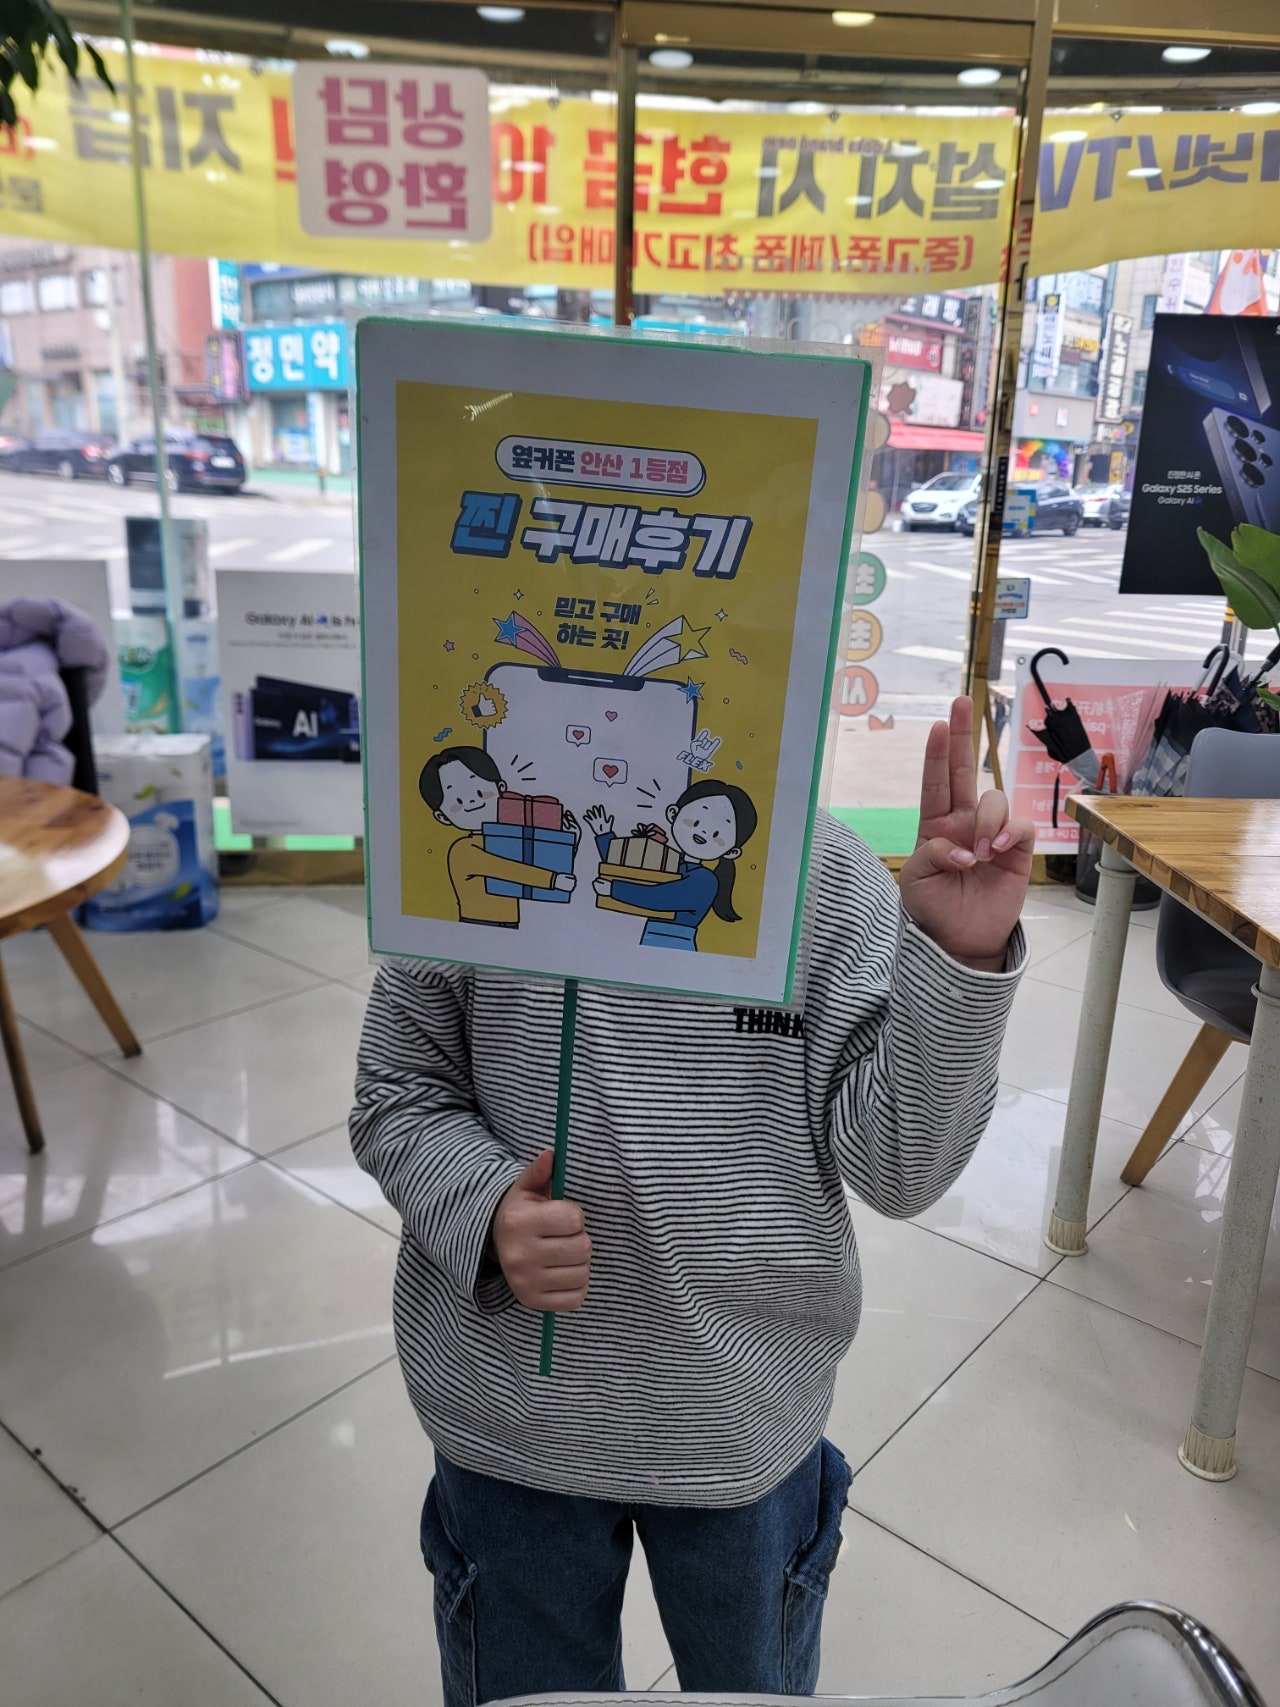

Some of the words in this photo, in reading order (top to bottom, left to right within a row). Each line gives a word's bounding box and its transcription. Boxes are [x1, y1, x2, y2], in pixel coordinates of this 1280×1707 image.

[511, 443, 576, 474] 옆커폰
[579, 450, 624, 478] 안산
[629, 456, 690, 485] 1등점
[1141, 483, 1176, 496] Galaxy
[1176, 484, 1194, 494] S25
[1193, 484, 1223, 495] Series
[1157, 496, 1187, 507] Galaxy
[1186, 497, 1195, 505] AI
[450, 490, 523, 559] 찐
[520, 496, 754, 580] 구매후기
[554, 596, 597, 622] 믿고
[600, 600, 642, 626] 구매
[555, 622, 597, 648] 하는
[600, 627, 630, 651] 곳!
[292, 709, 320, 739] AI
[676, 750, 714, 772] FLEX
[733, 1008, 805, 1040] THINK
